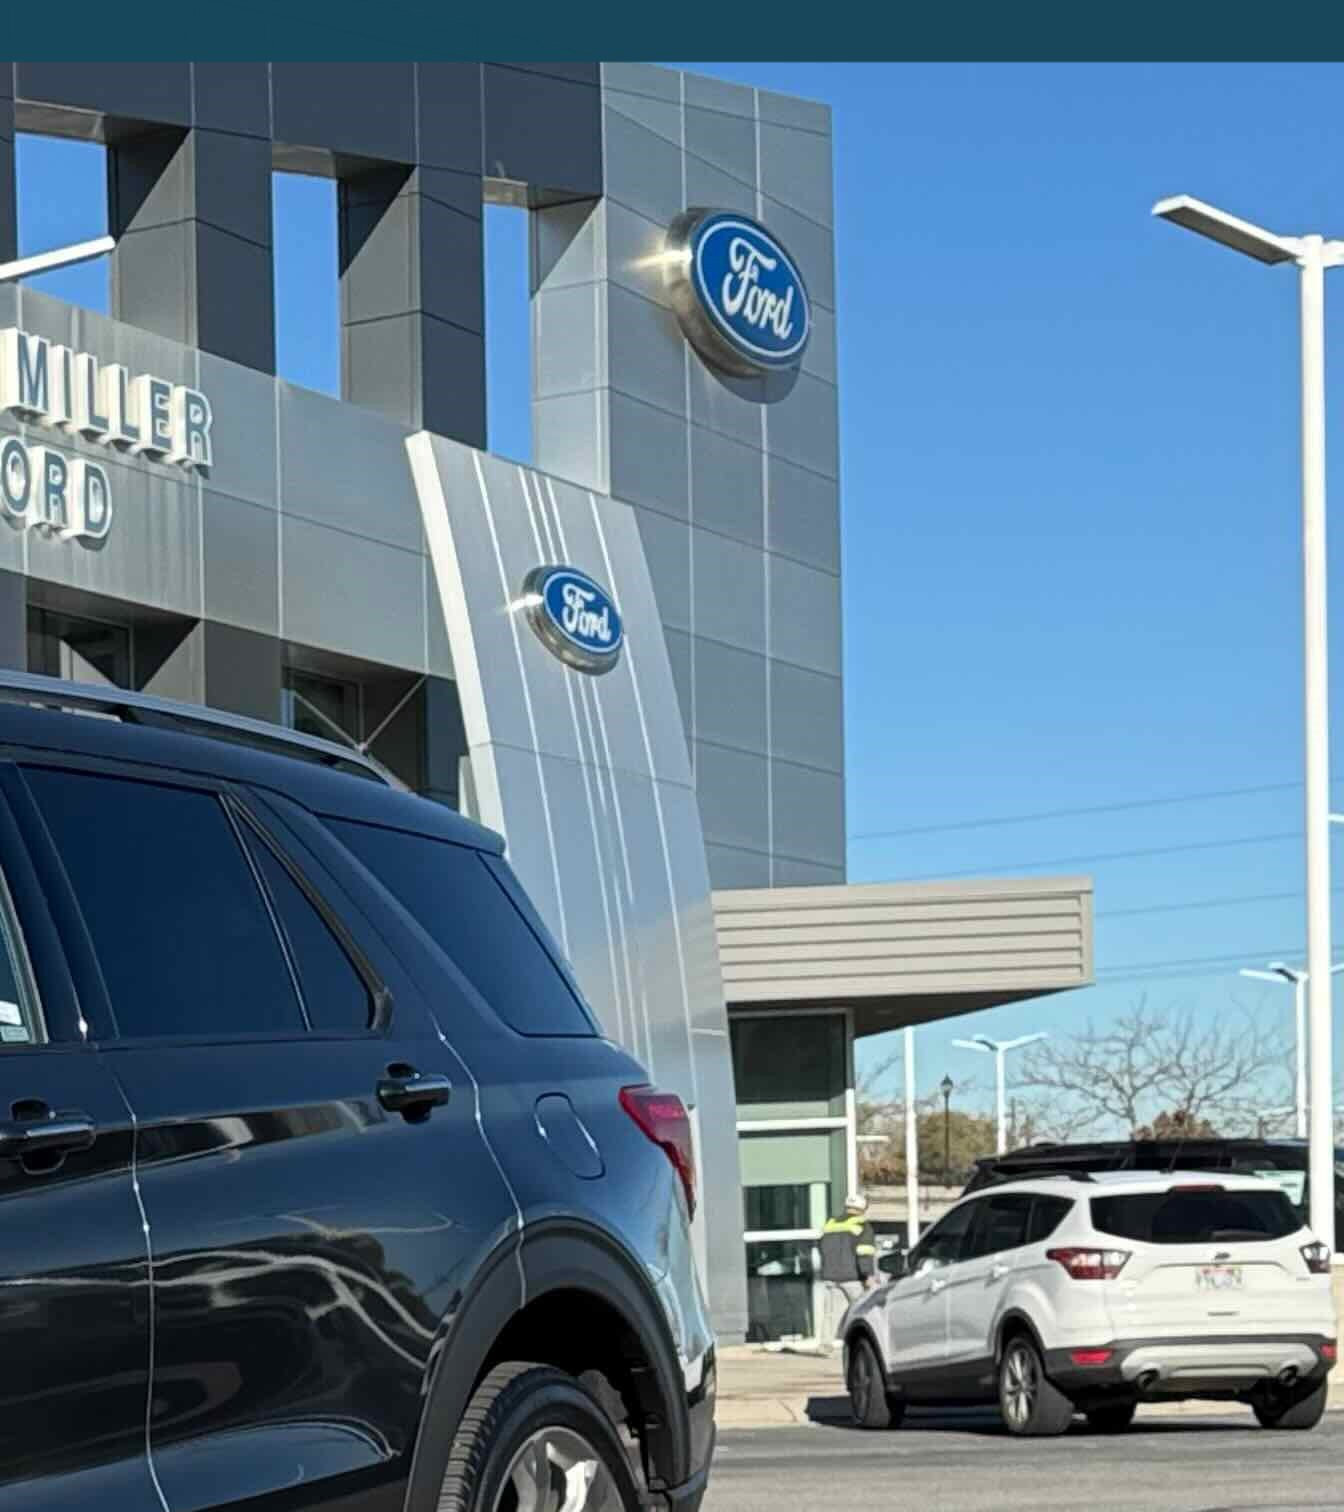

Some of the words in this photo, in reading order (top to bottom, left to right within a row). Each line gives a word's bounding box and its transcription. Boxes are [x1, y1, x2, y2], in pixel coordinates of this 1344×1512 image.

[722, 237, 795, 340] Ford
[2, 327, 212, 467] MILLER
[560, 582, 613, 642] Ford
